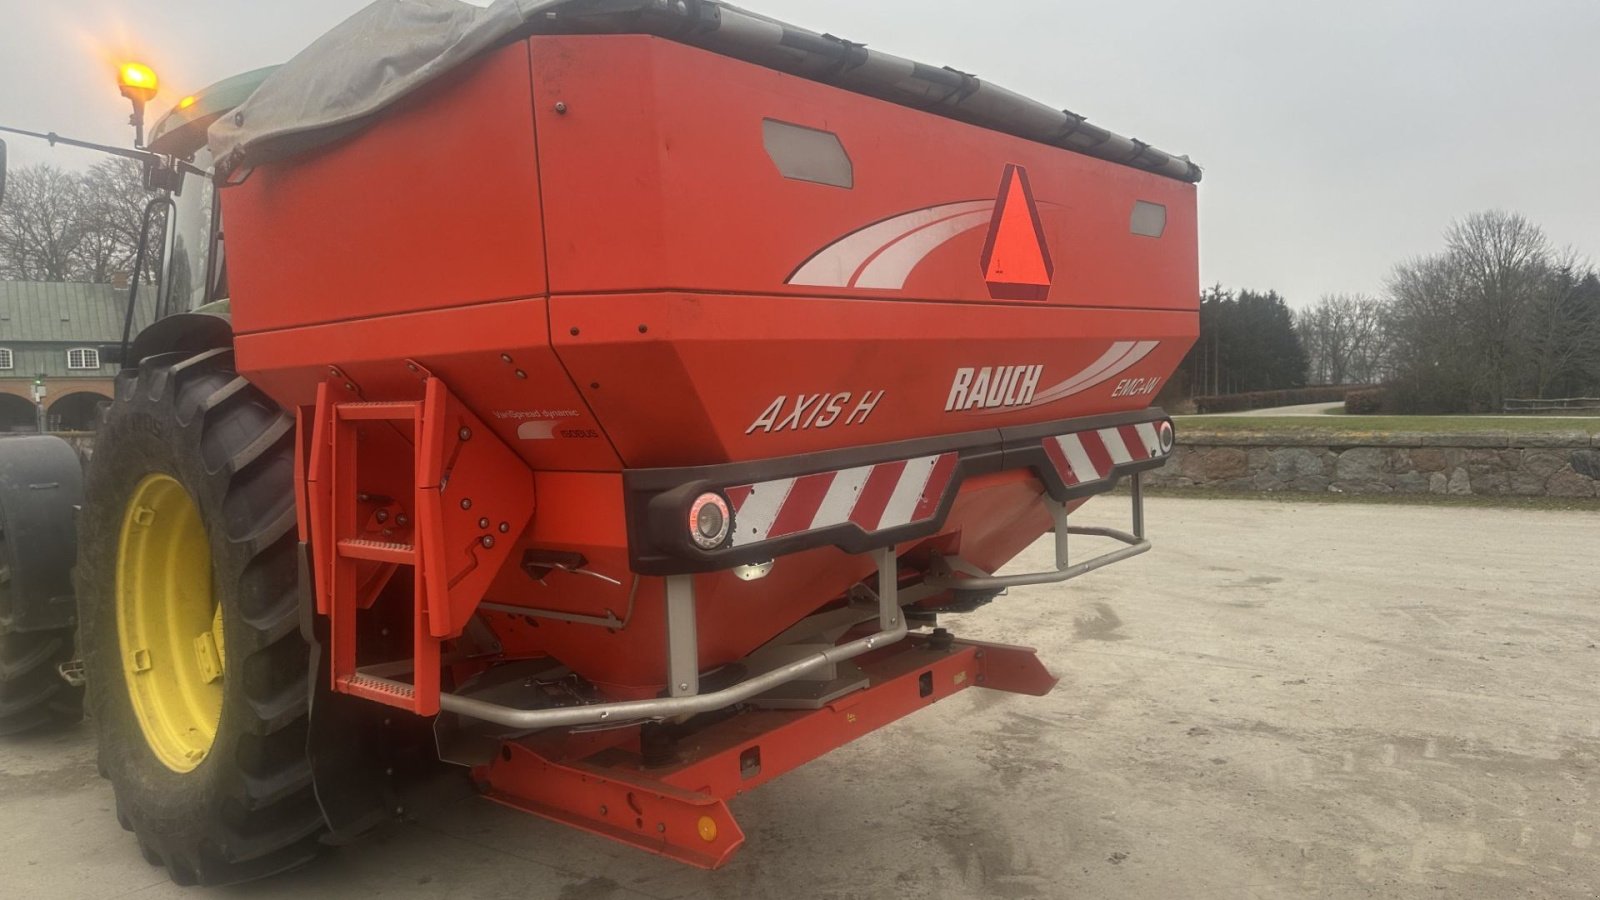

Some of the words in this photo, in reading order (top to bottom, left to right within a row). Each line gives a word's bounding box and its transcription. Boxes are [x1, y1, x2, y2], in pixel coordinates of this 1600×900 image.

[944, 364, 1044, 412] RAUCH
[541, 409, 580, 419] dynamic
[744, 391, 852, 435] AXIS
[845, 389, 885, 425] H
[560, 429, 600, 438] ISOBUS
